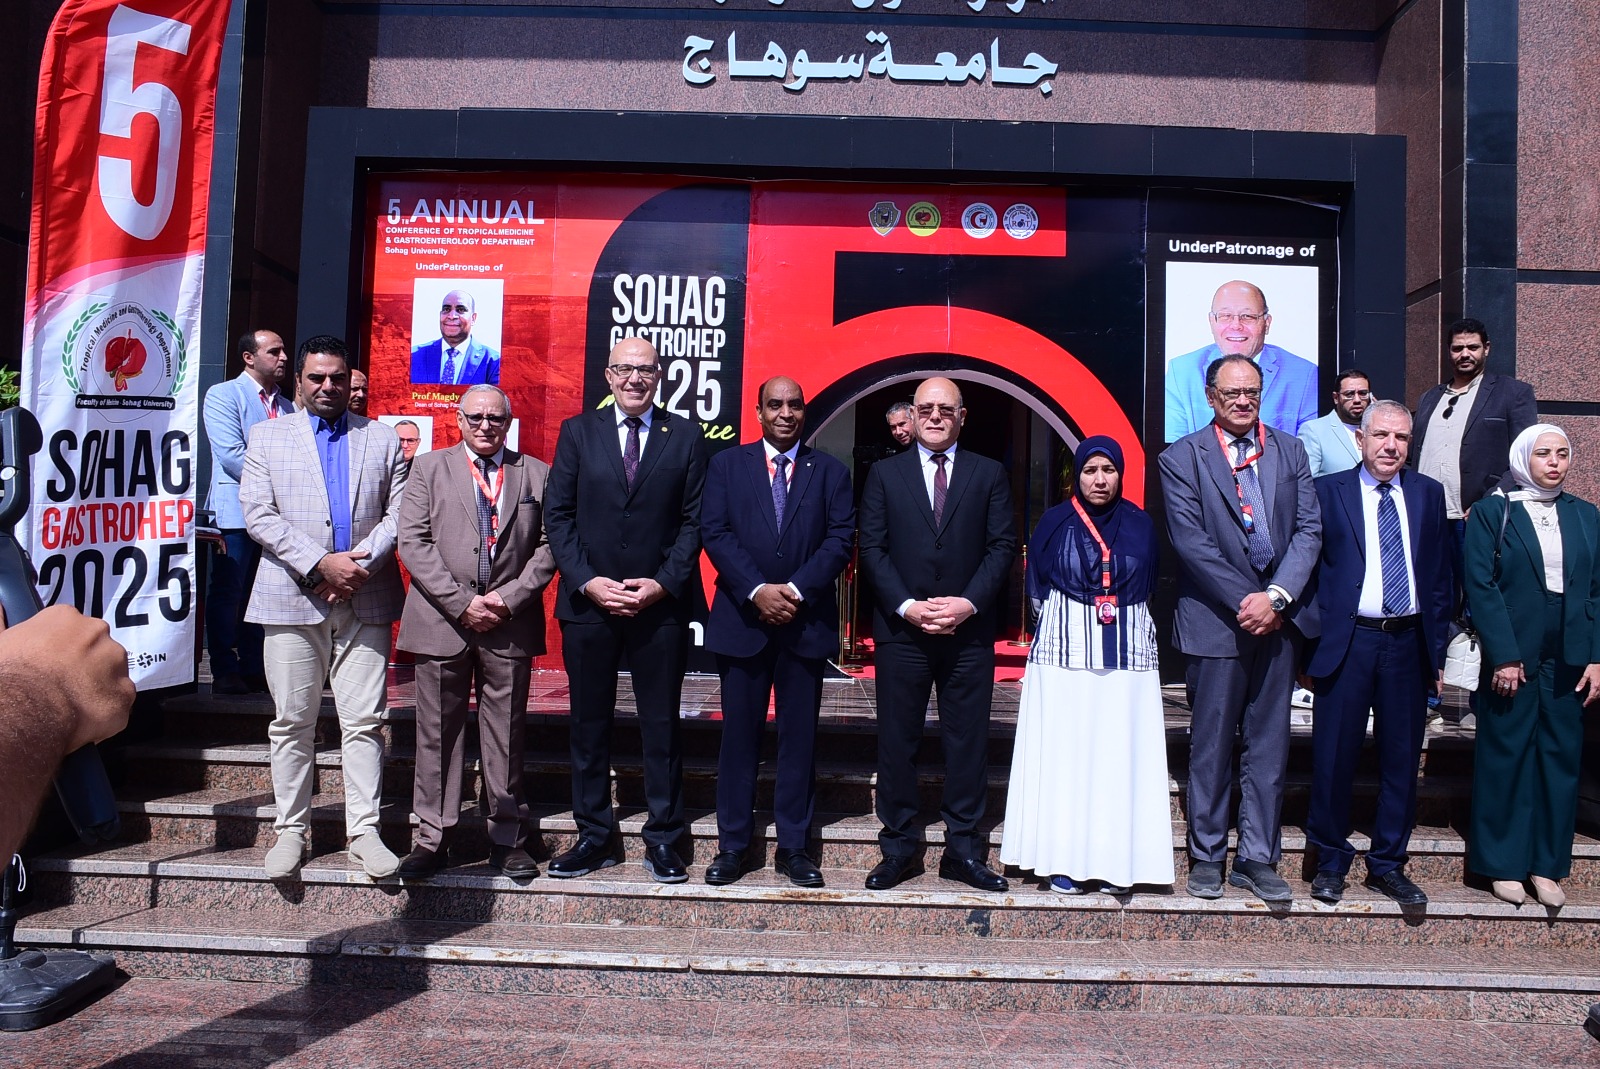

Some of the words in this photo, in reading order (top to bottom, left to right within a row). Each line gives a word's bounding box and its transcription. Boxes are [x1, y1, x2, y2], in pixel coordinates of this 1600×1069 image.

[682, 30, 865, 90] سوهاج
[866, 30, 1059, 95] جامعة
[98, 4, 192, 241] 5
[385, 227, 441, 235] CONFERENCE
[409, 199, 545, 225] ANNUAL
[384, 247, 409, 256] Sohag
[410, 247, 448, 256] University
[393, 237, 479, 245] GASTROENTEROLOGY
[482, 238, 535, 246] DEPARTMENT
[1169, 239, 1295, 259] UnderPatronage
[1299, 244, 1316, 257] of
[415, 263, 491, 273] UnderPatronage
[493, 263, 504, 272] of
[611, 273, 726, 327] SOHAG
[80, 335, 96, 373] Tropical
[93, 311, 118, 338] Medicine
[118, 304, 127, 316] and
[155, 332, 171, 378] Department
[76, 398, 98, 407] Faculty
[122, 399, 141, 407] Sohag
[143, 400, 173, 409] University
[46, 429, 191, 503] SOHAG
[42, 500, 194, 550] GASTROHEP
[38, 542, 192, 629] 2025
